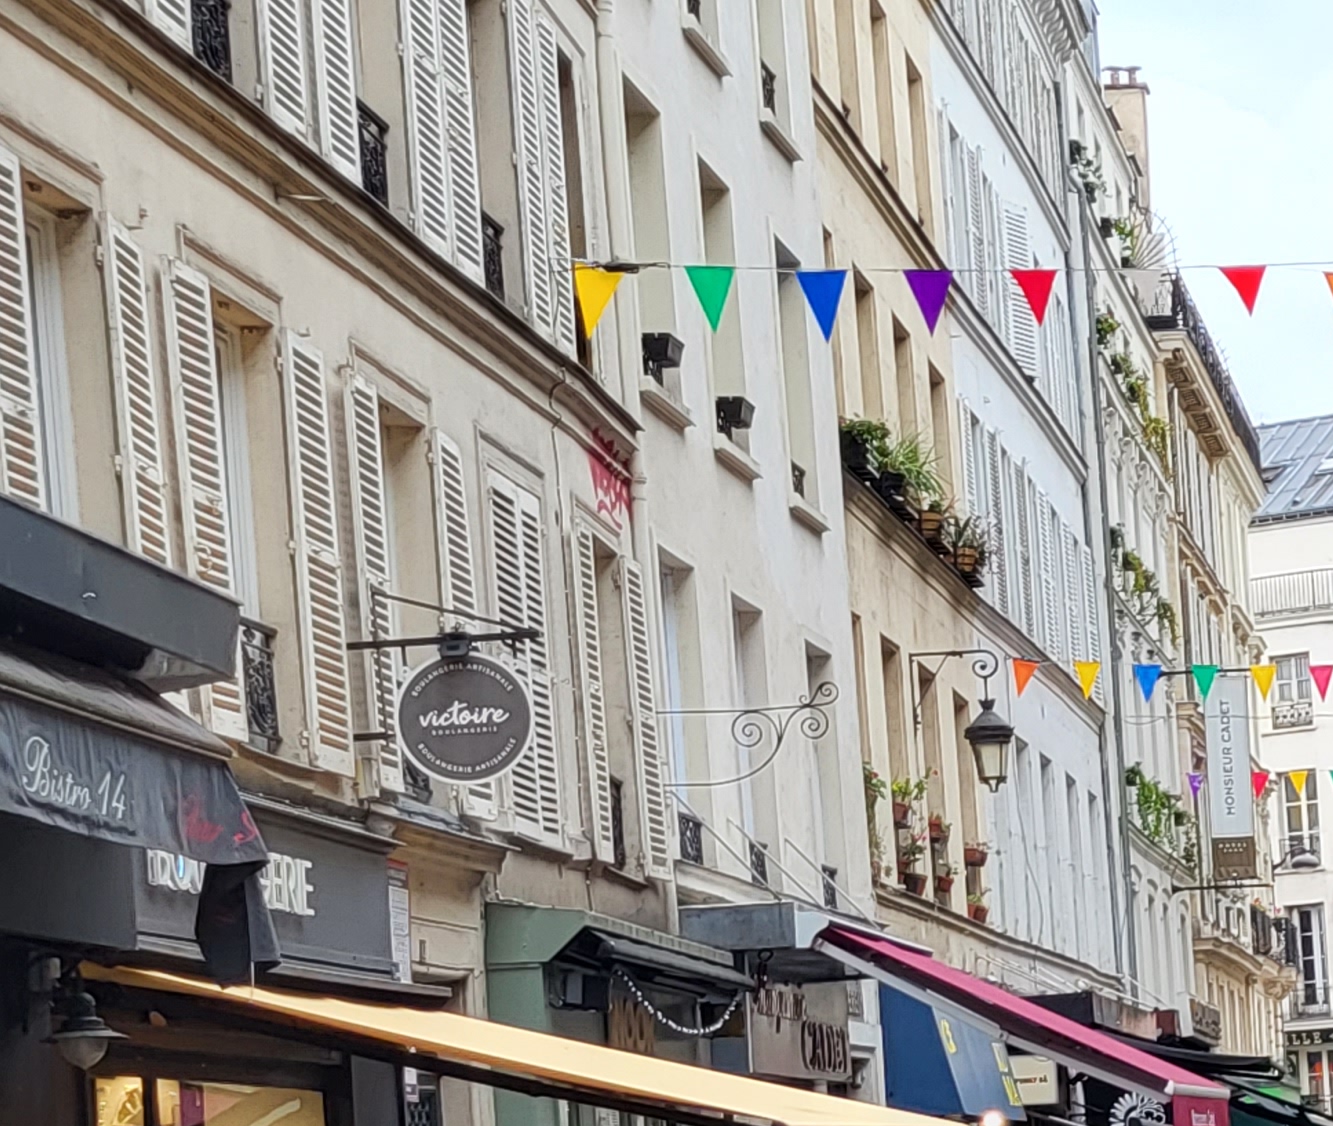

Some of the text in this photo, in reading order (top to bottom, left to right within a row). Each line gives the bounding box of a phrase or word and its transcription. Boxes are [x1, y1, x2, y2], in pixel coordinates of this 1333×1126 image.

[411, 662, 514, 697] BOULANGERIE ARTISANALE
[419, 700, 510, 727] victoire
[431, 725, 498, 736] BOULANGERIE
[418, 737, 517, 773] BOULANGERIE ARTISANALE
[1219, 699, 1236, 816] MONSIEUR CADET
[22, 736, 126, 819] Bistro 14
